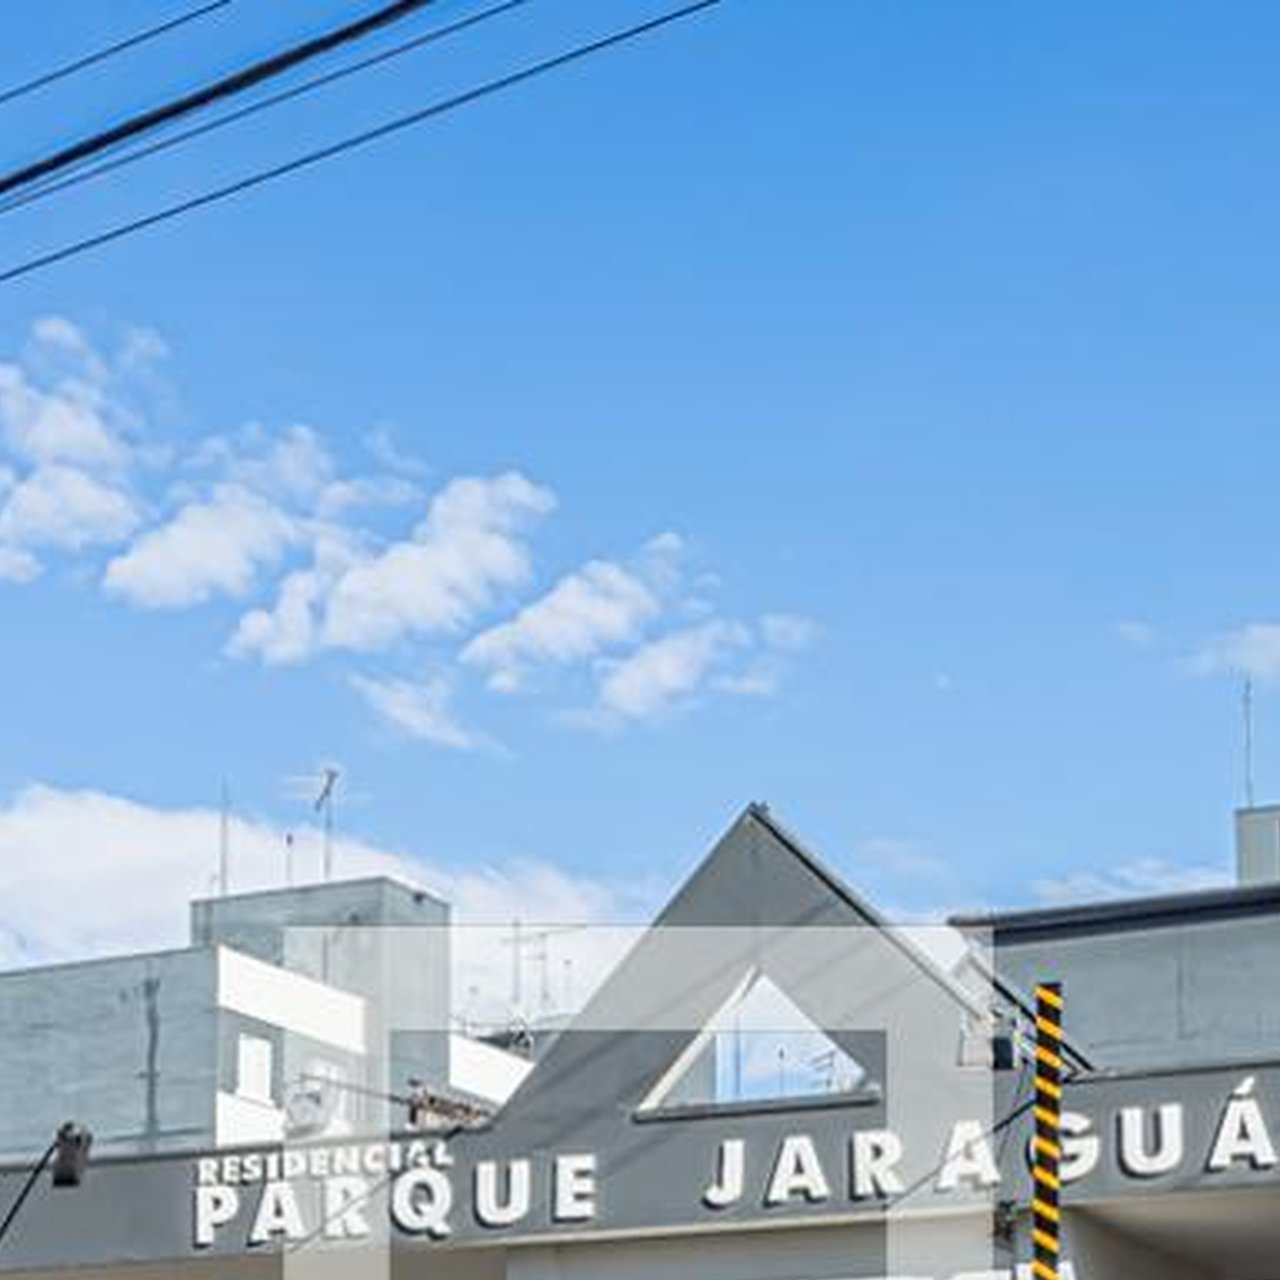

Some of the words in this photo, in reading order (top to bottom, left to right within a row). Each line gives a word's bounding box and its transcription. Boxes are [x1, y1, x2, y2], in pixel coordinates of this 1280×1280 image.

[194, 1153, 598, 1247] PARQUE
[703, 1075, 1280, 1206] JARAGUÁ
[198, 1139, 454, 1184] RESIDENCIAL
